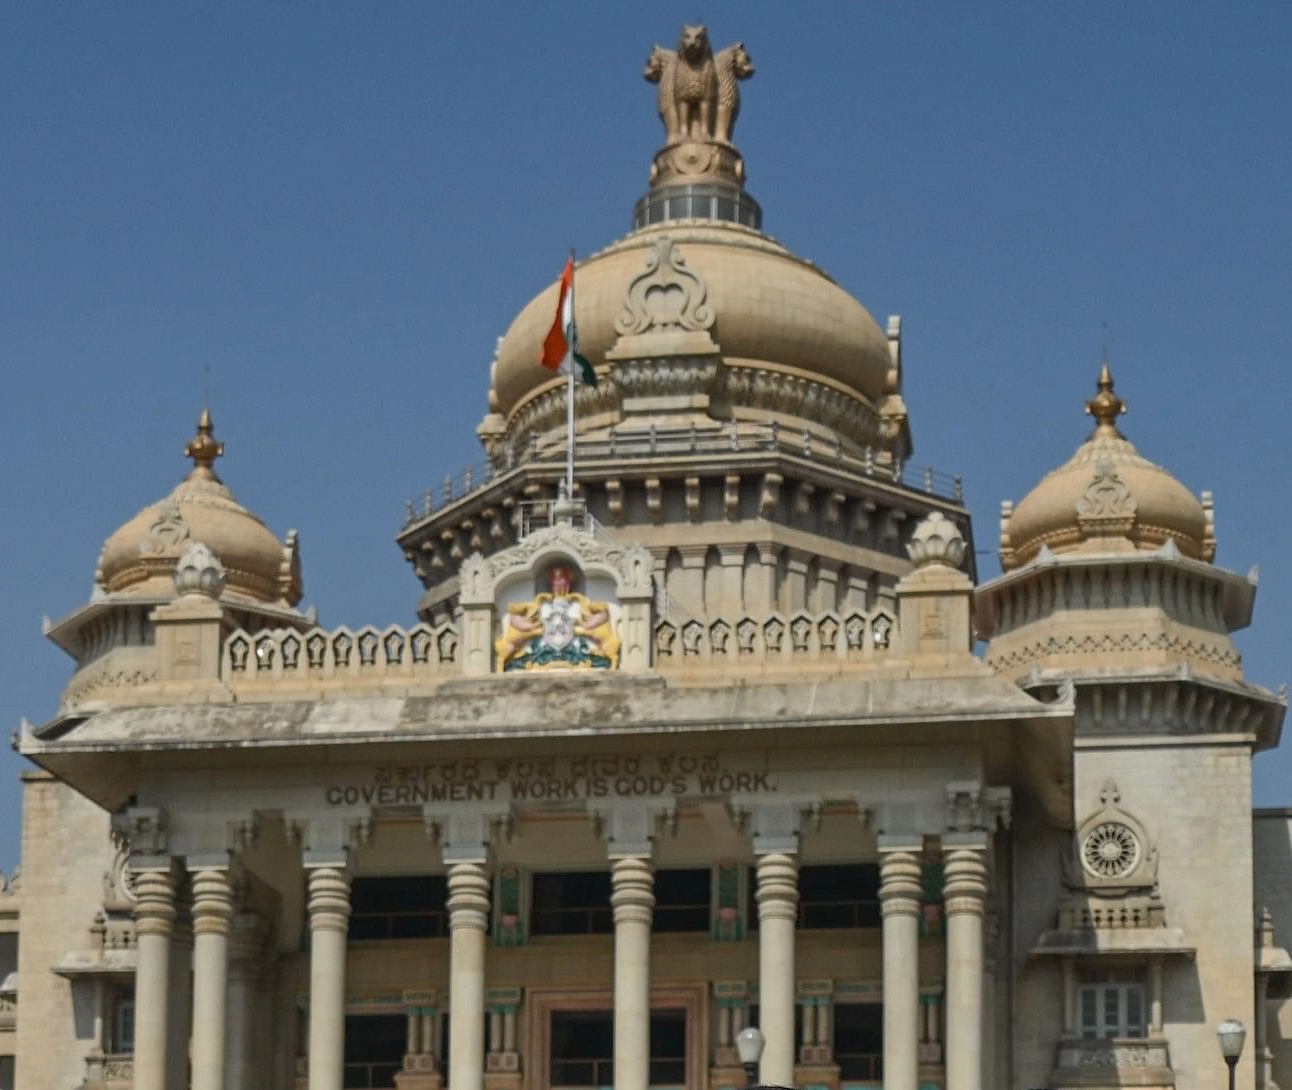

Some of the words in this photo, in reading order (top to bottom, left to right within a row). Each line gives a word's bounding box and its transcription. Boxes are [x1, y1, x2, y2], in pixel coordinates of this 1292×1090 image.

[326, 781, 499, 805] GOVERNMENT
[511, 778, 579, 800] WORK
[586, 777, 608, 798] IS
[614, 775, 688, 797] GOD'S
[698, 772, 778, 794] WORK.
